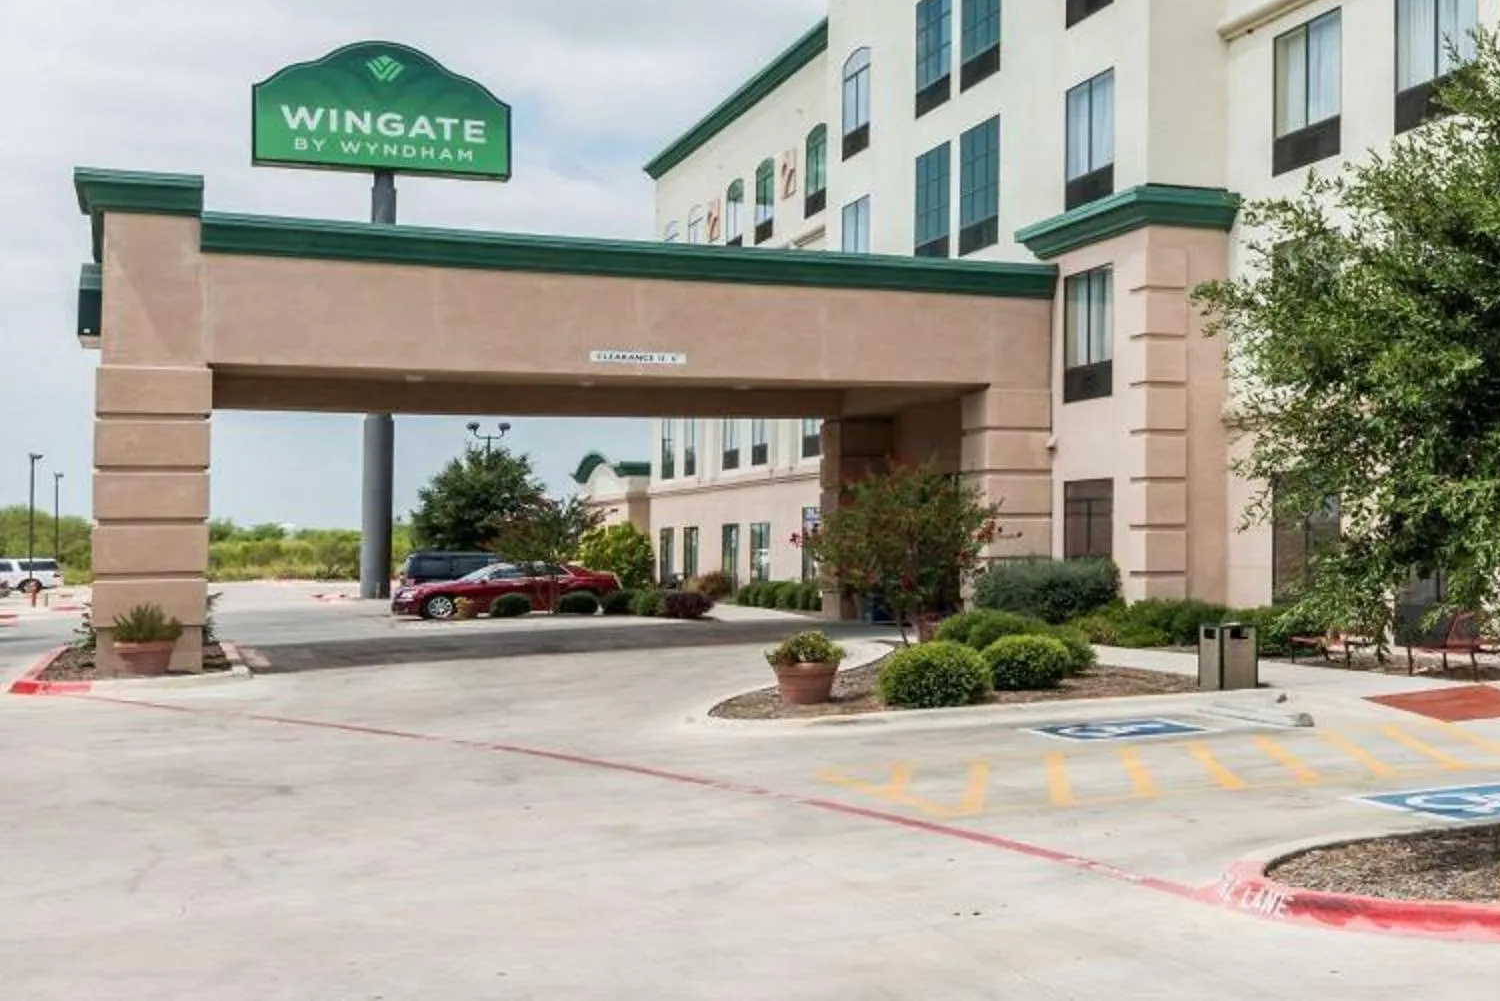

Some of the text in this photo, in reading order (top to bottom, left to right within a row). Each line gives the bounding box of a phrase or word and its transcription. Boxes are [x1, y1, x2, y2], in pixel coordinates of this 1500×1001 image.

[279, 104, 487, 144] WINGATE
[294, 137, 474, 162] BY WYNDHAM
[1241, 884, 1294, 919] LANE
